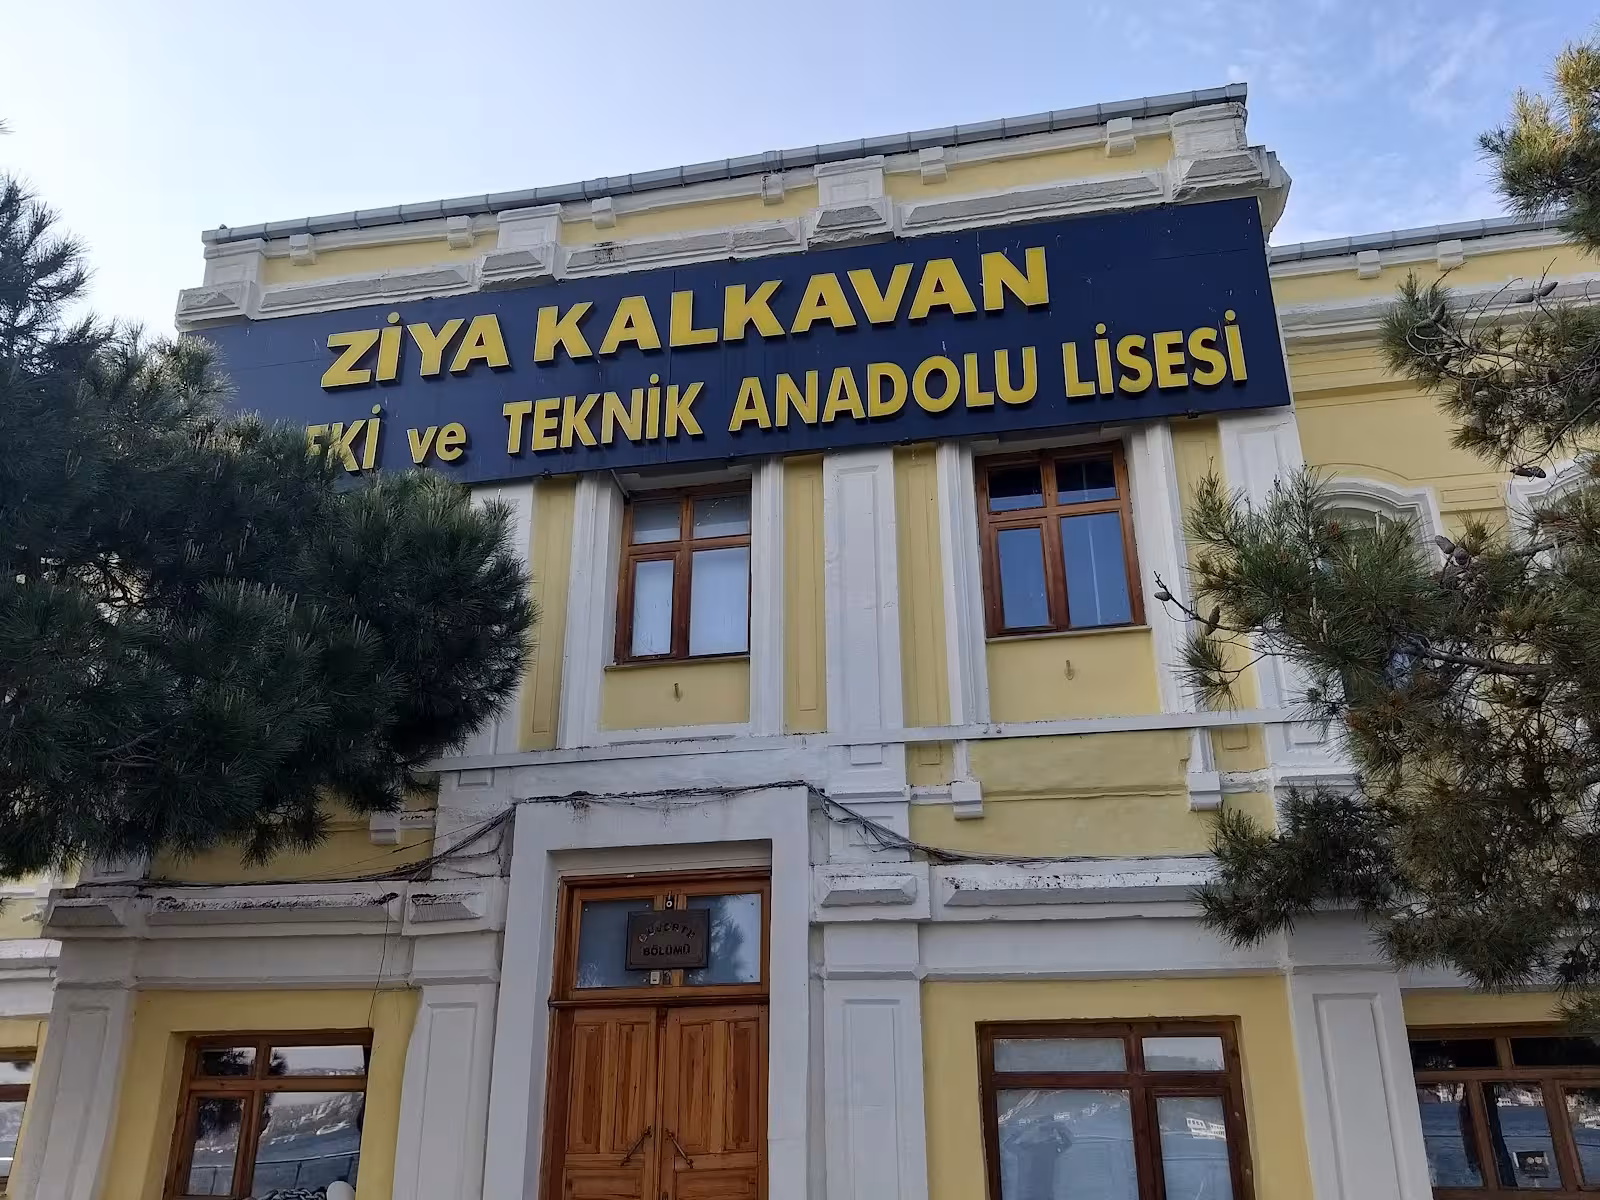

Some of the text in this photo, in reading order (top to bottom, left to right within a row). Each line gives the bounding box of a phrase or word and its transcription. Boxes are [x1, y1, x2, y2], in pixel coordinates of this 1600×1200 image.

[320, 245, 1050, 390] ZİYA KALKAVAN
[406, 421, 468, 465] ve
[502, 373, 705, 457] TEKNİK
[728, 345, 1038, 433] ANADOLU
[1061, 309, 1249, 400] LİSESİ
